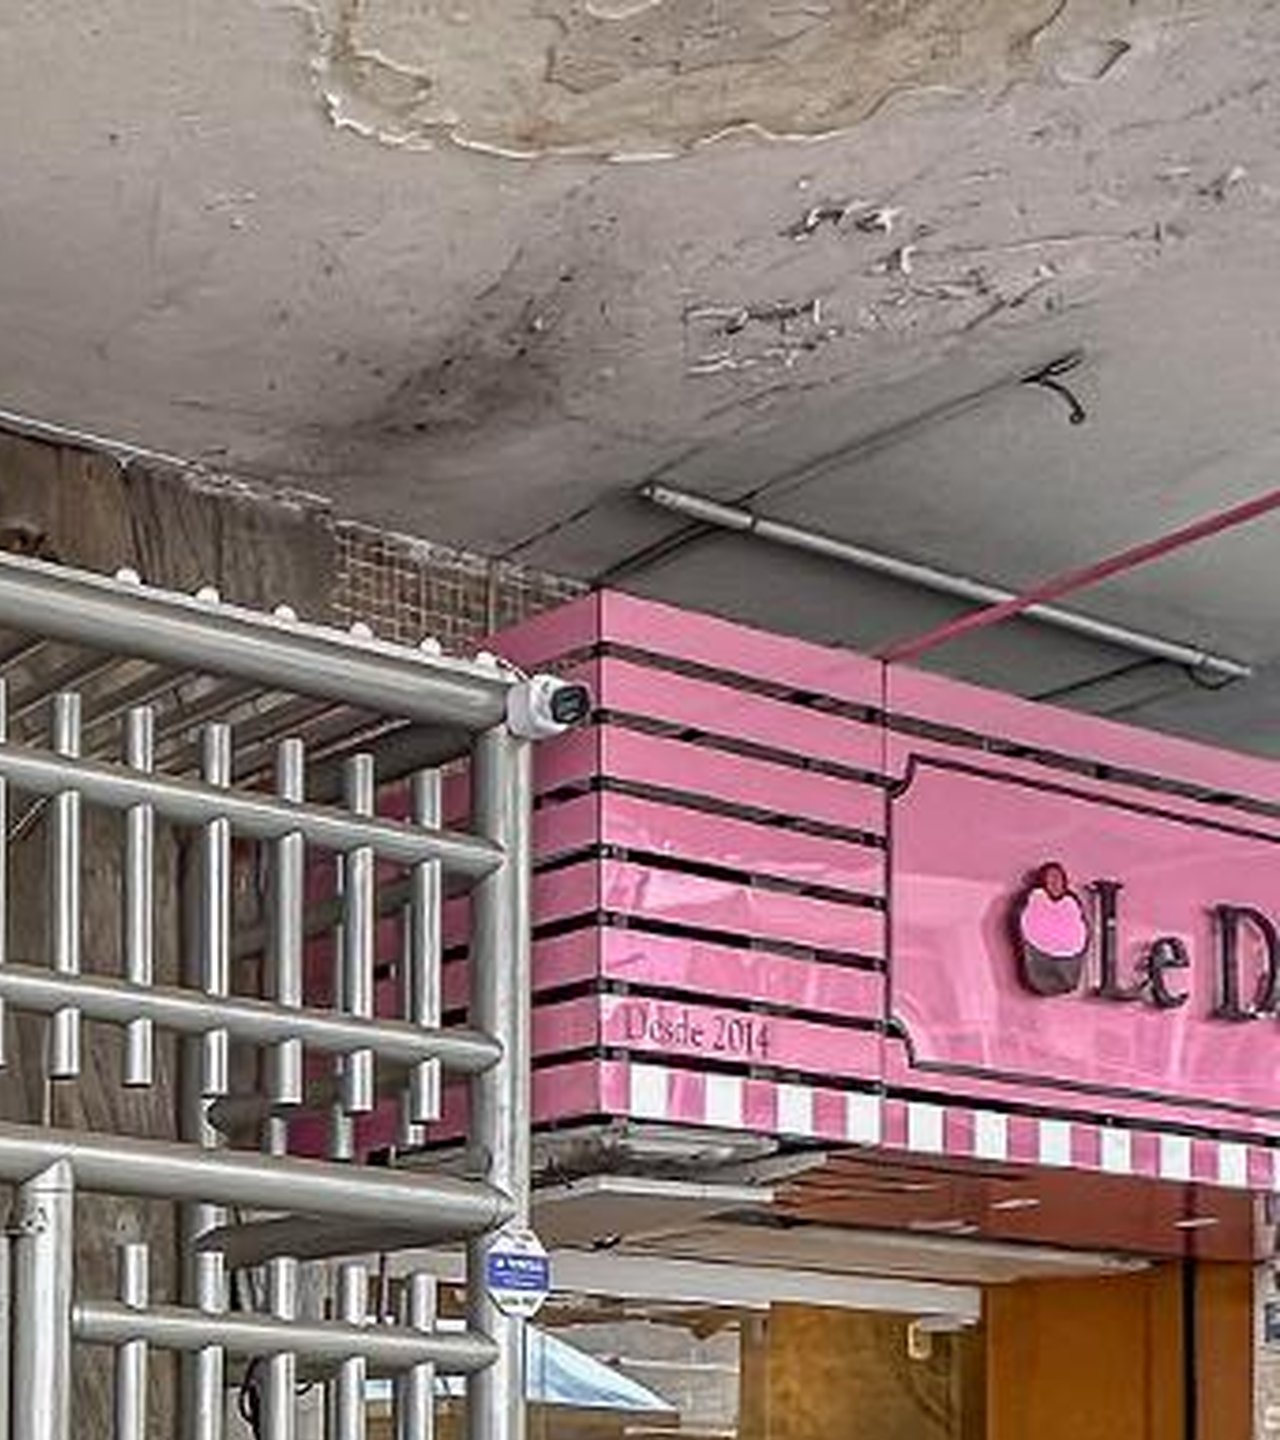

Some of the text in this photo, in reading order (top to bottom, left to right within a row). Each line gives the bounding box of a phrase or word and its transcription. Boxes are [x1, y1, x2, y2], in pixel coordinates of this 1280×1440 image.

[1085, 879, 1190, 1009] Le
[625, 1002, 770, 1060] Desde 2014
